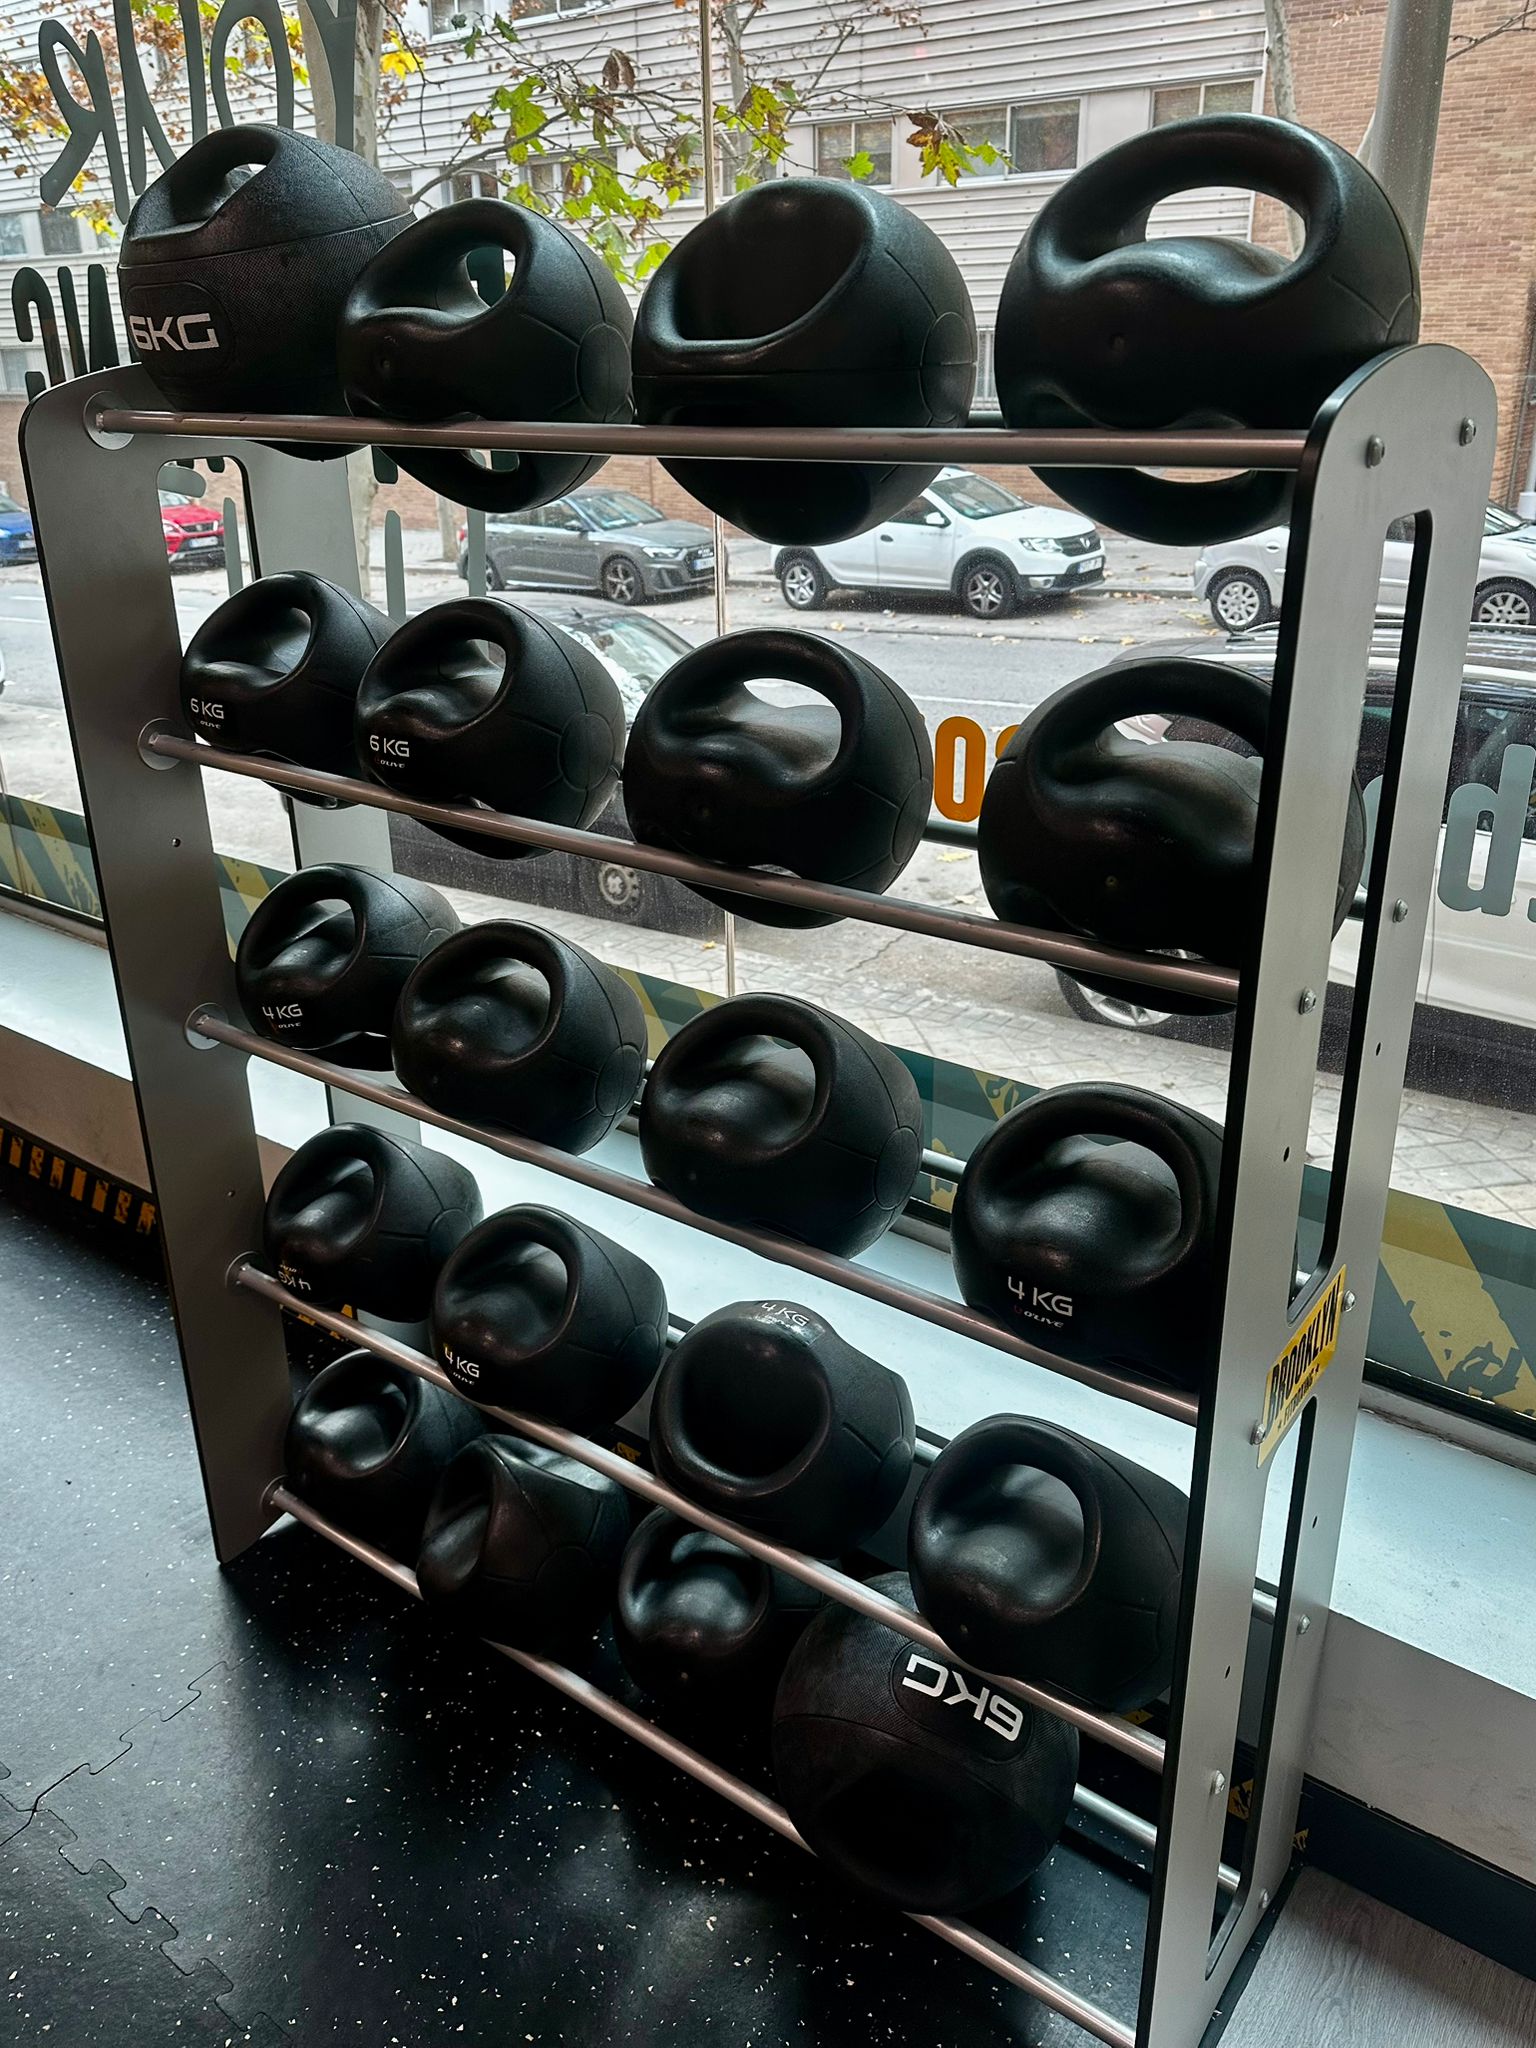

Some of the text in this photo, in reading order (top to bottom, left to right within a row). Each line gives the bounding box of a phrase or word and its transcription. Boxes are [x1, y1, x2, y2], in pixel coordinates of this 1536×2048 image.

[129, 312, 220, 351] 6KG
[190, 697, 225, 720] 6 KG
[369, 734, 410, 758] 6 KG
[261, 1003, 304, 1020] 4 KG
[277, 1270, 312, 1291] 4 KG
[1007, 1275, 1073, 1317] 4 KG
[761, 1302, 777, 1312] 4
[774, 1307, 810, 1327] KG
[444, 1346, 454, 1365] 4
[456, 1356, 480, 1379] KG
[1265, 1274, 1341, 1436] BROOKLYN
[901, 1653, 1024, 1742] 6KG
